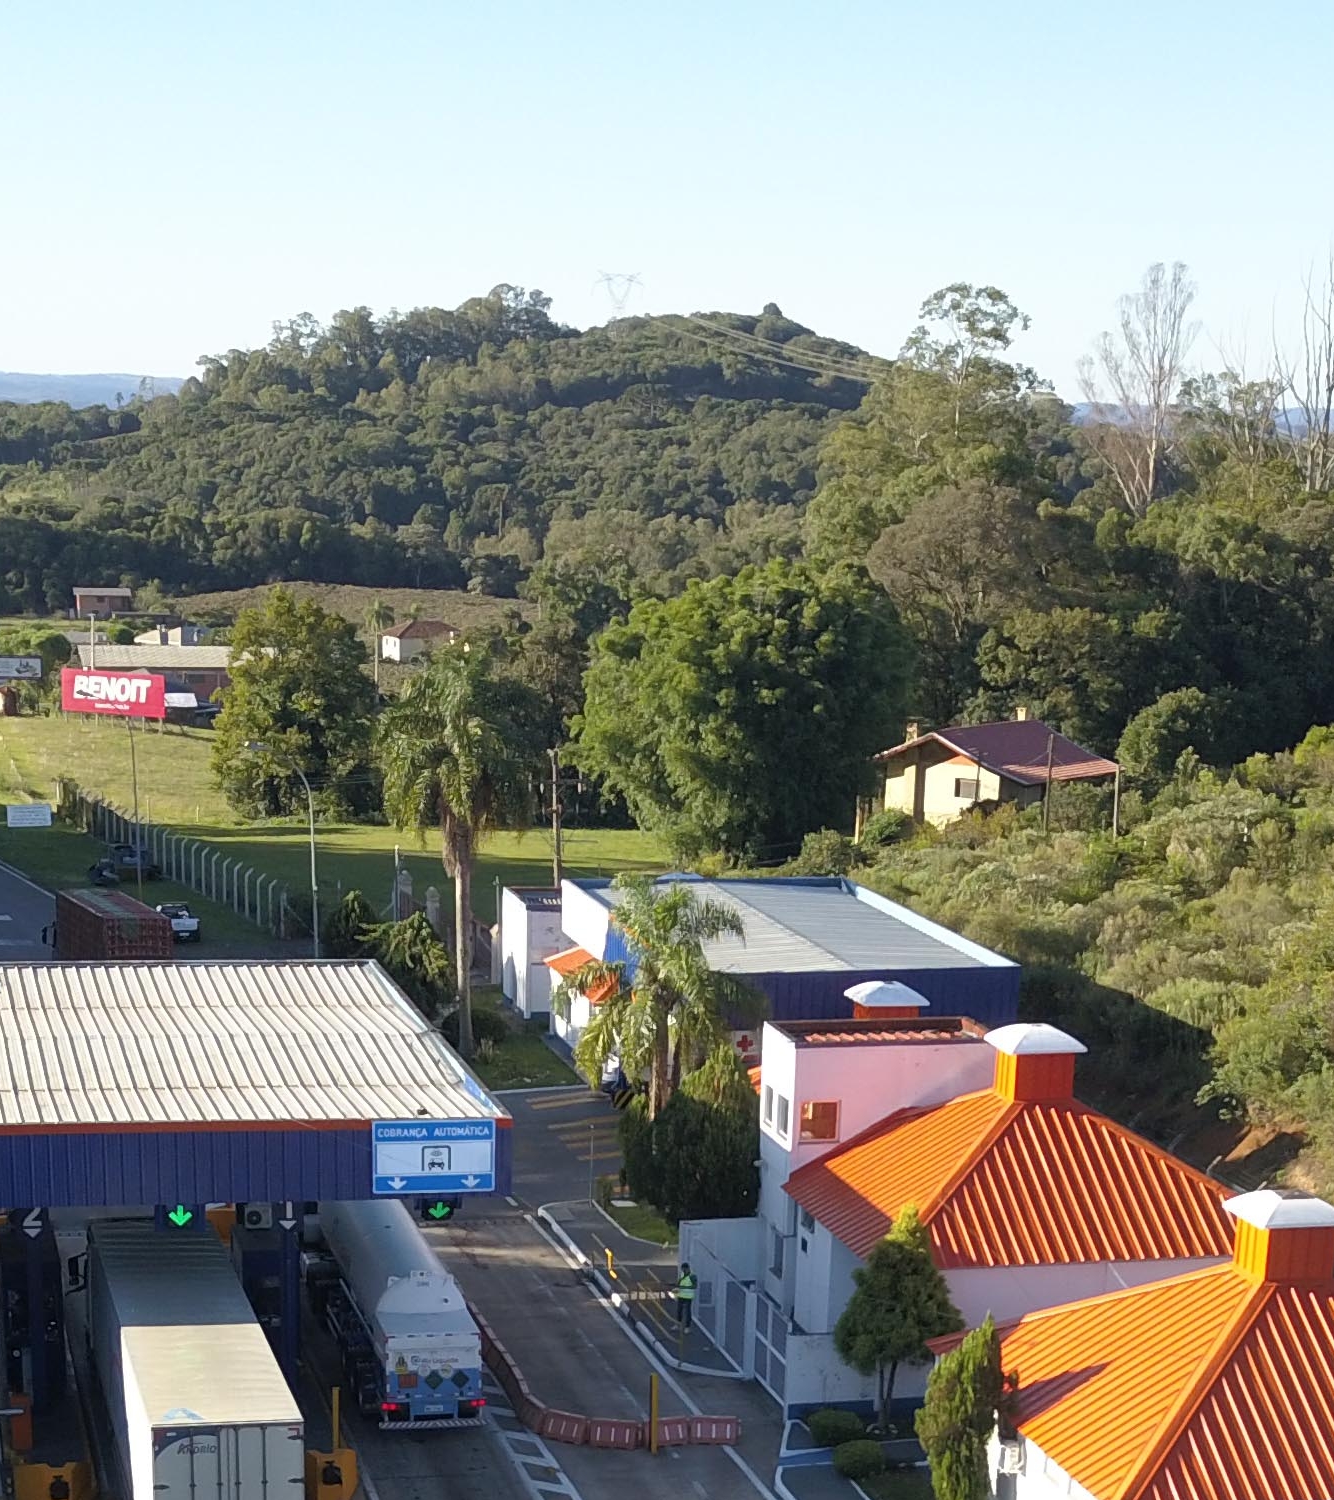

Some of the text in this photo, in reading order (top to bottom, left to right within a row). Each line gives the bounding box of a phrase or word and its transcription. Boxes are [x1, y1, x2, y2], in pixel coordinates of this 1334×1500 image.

[73, 674, 152, 704] BENOIT
[377, 1124, 490, 1139] COBRANÇA AUTOMÁTICA
